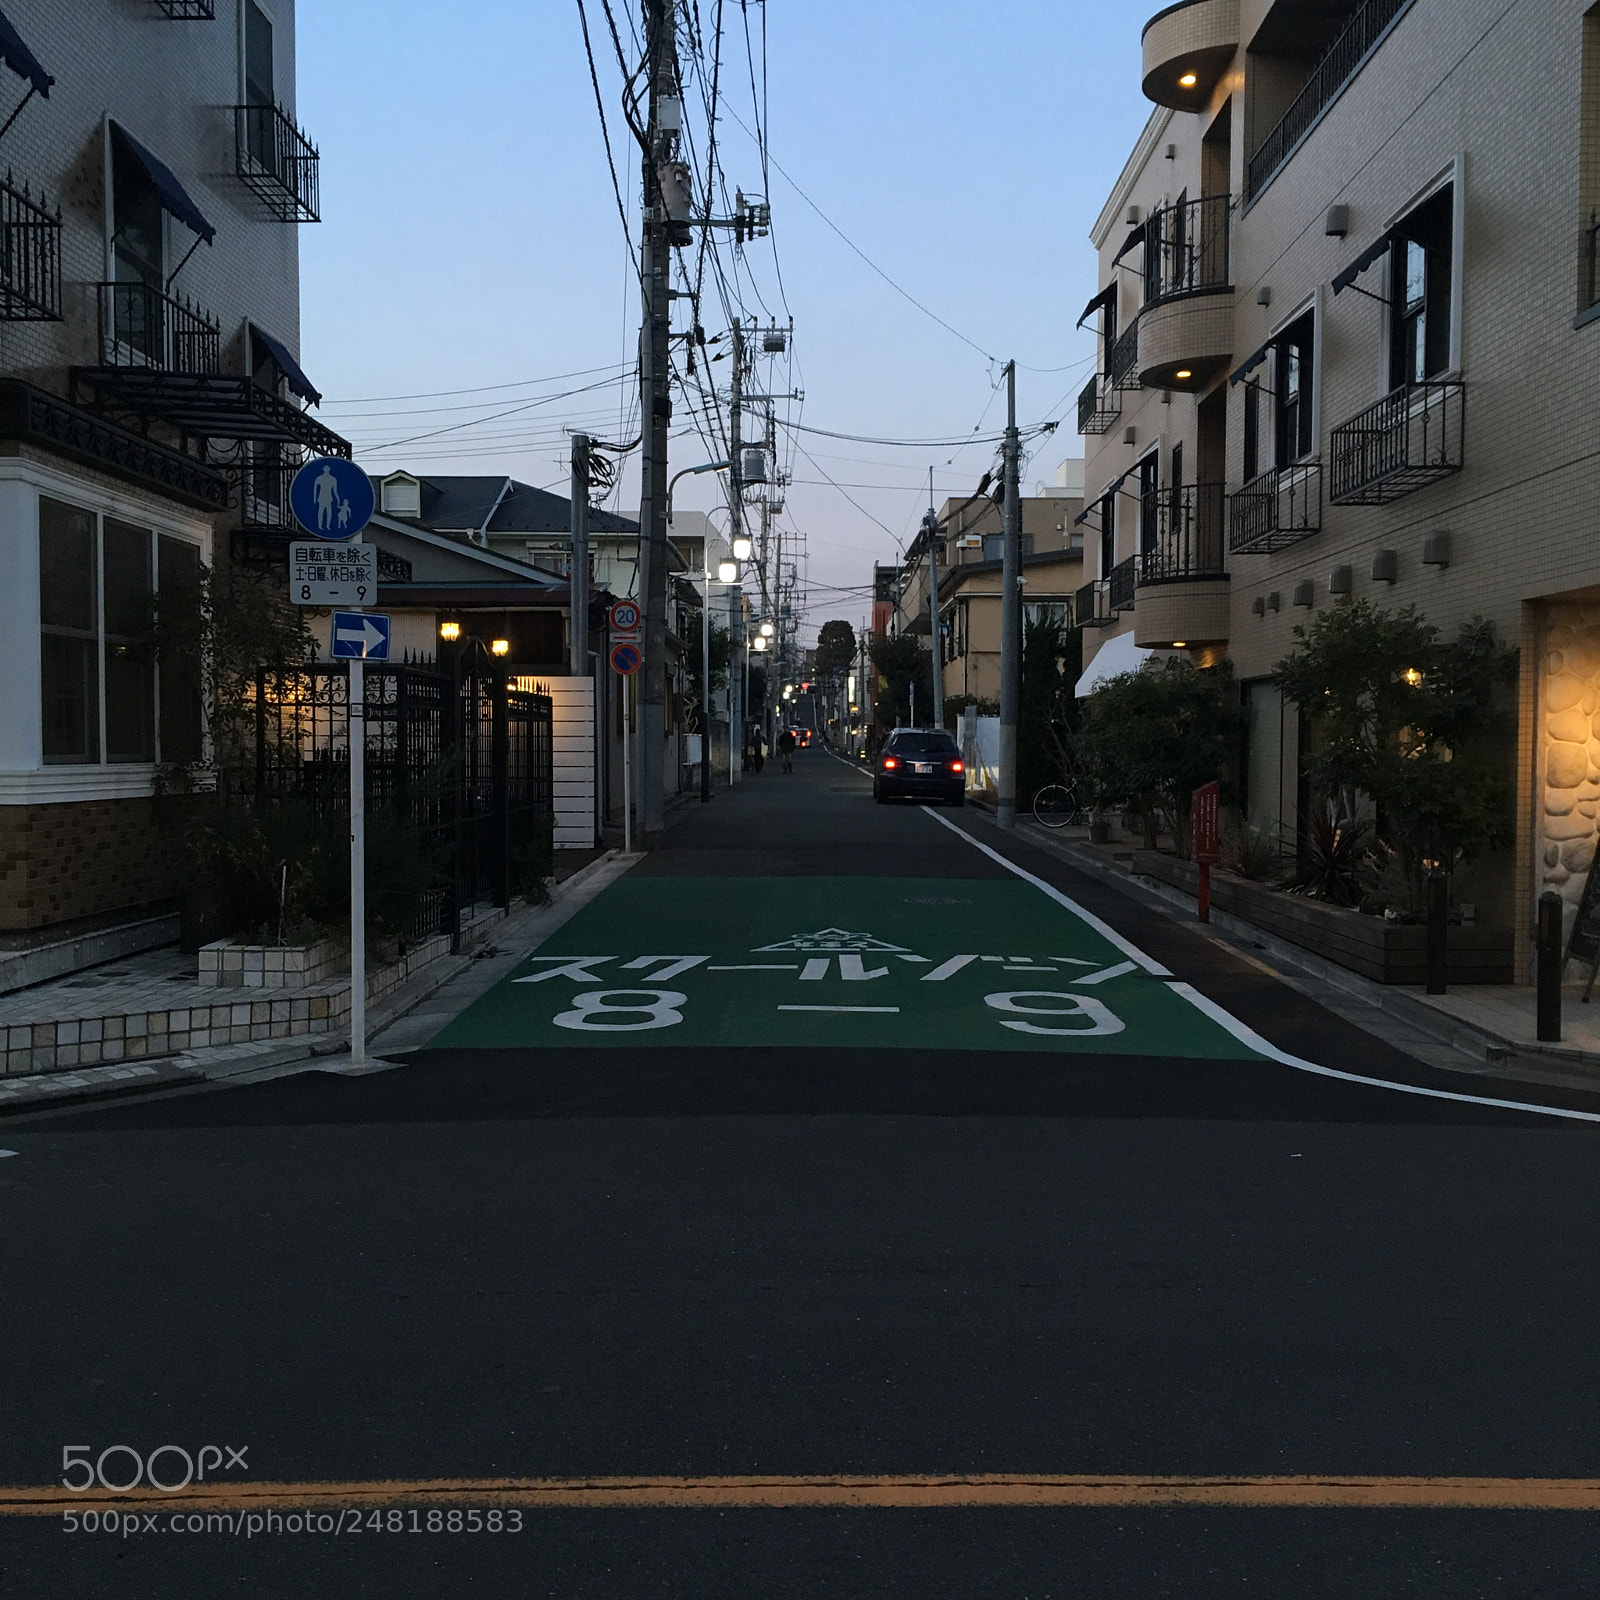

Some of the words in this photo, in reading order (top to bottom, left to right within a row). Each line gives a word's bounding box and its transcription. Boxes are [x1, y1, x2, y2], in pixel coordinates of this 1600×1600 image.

[295, 546, 371, 563] 自転車を除く
[301, 584, 311, 600] 8
[357, 585, 367, 601] 9
[617, 610, 634, 623] 20
[511, 954, 1139, 985] スクールゾーン
[552, 989, 688, 1032] 8
[983, 991, 1126, 1036] 9
